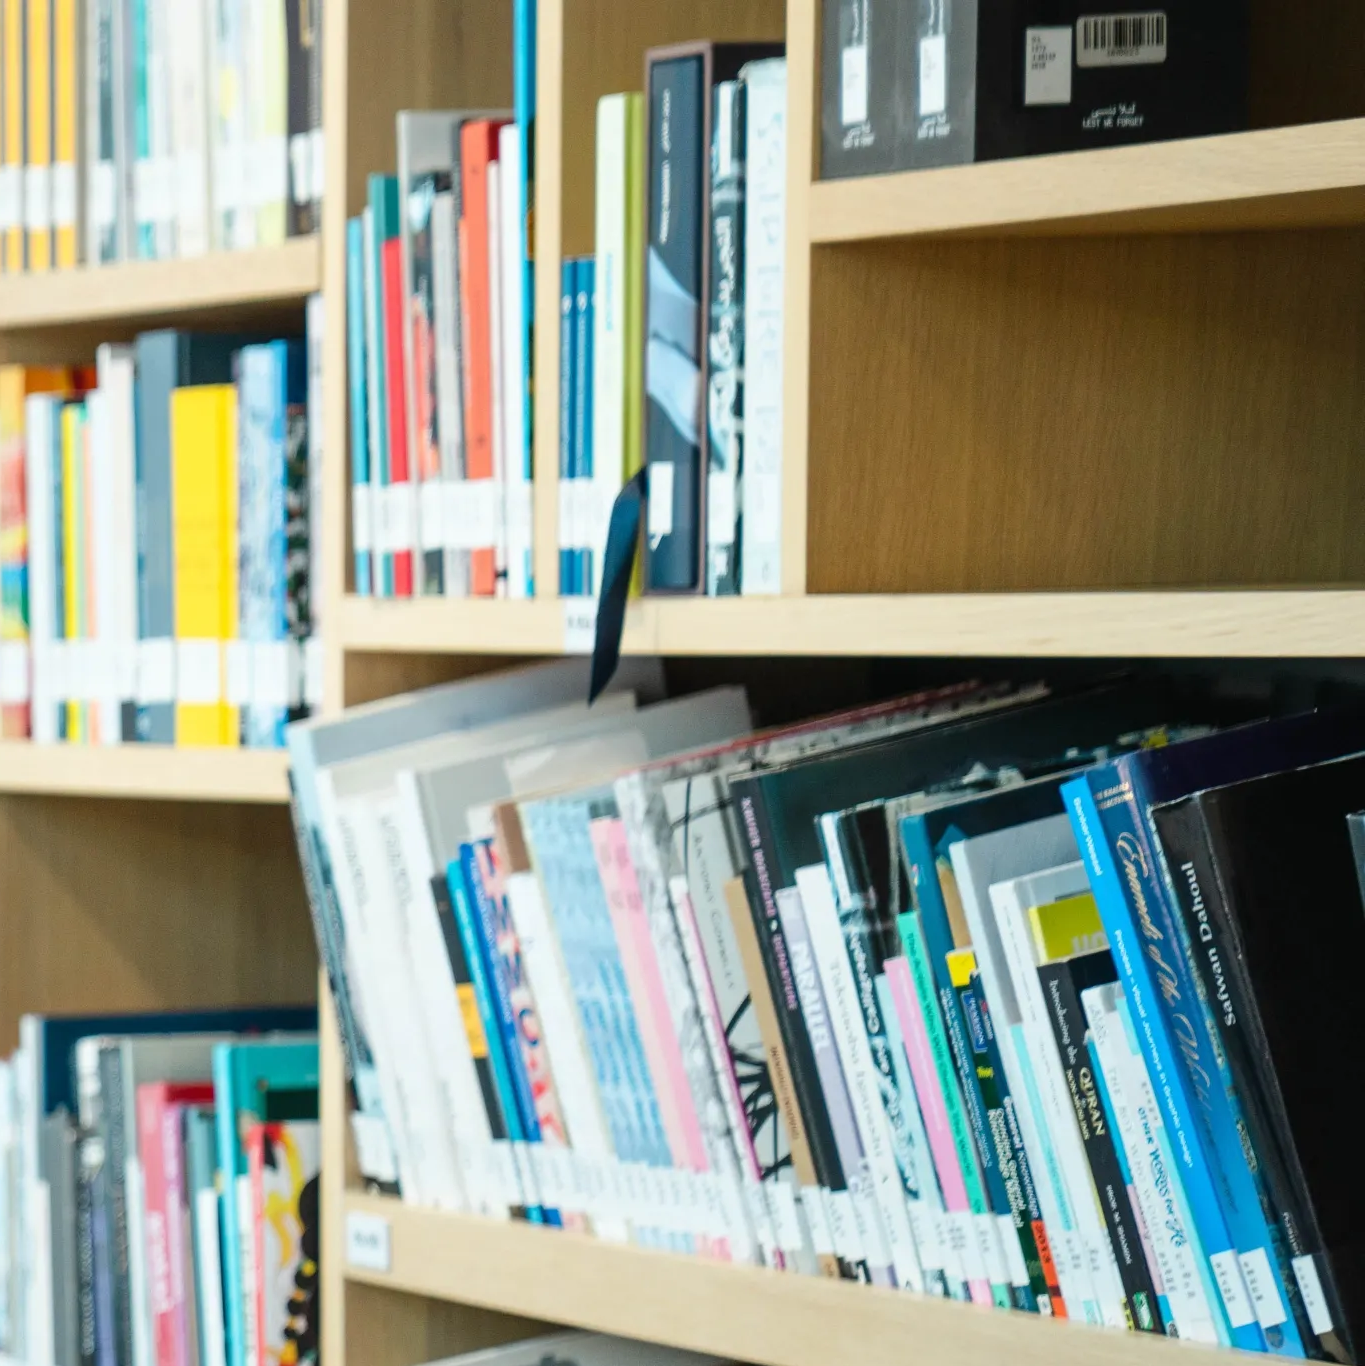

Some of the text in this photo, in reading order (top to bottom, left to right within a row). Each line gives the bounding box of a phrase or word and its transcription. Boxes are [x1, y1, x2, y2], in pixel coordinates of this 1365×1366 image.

[1180, 861, 1237, 1027] Safwan Dahoul
[1079, 1066, 1106, 1136] QURAN
